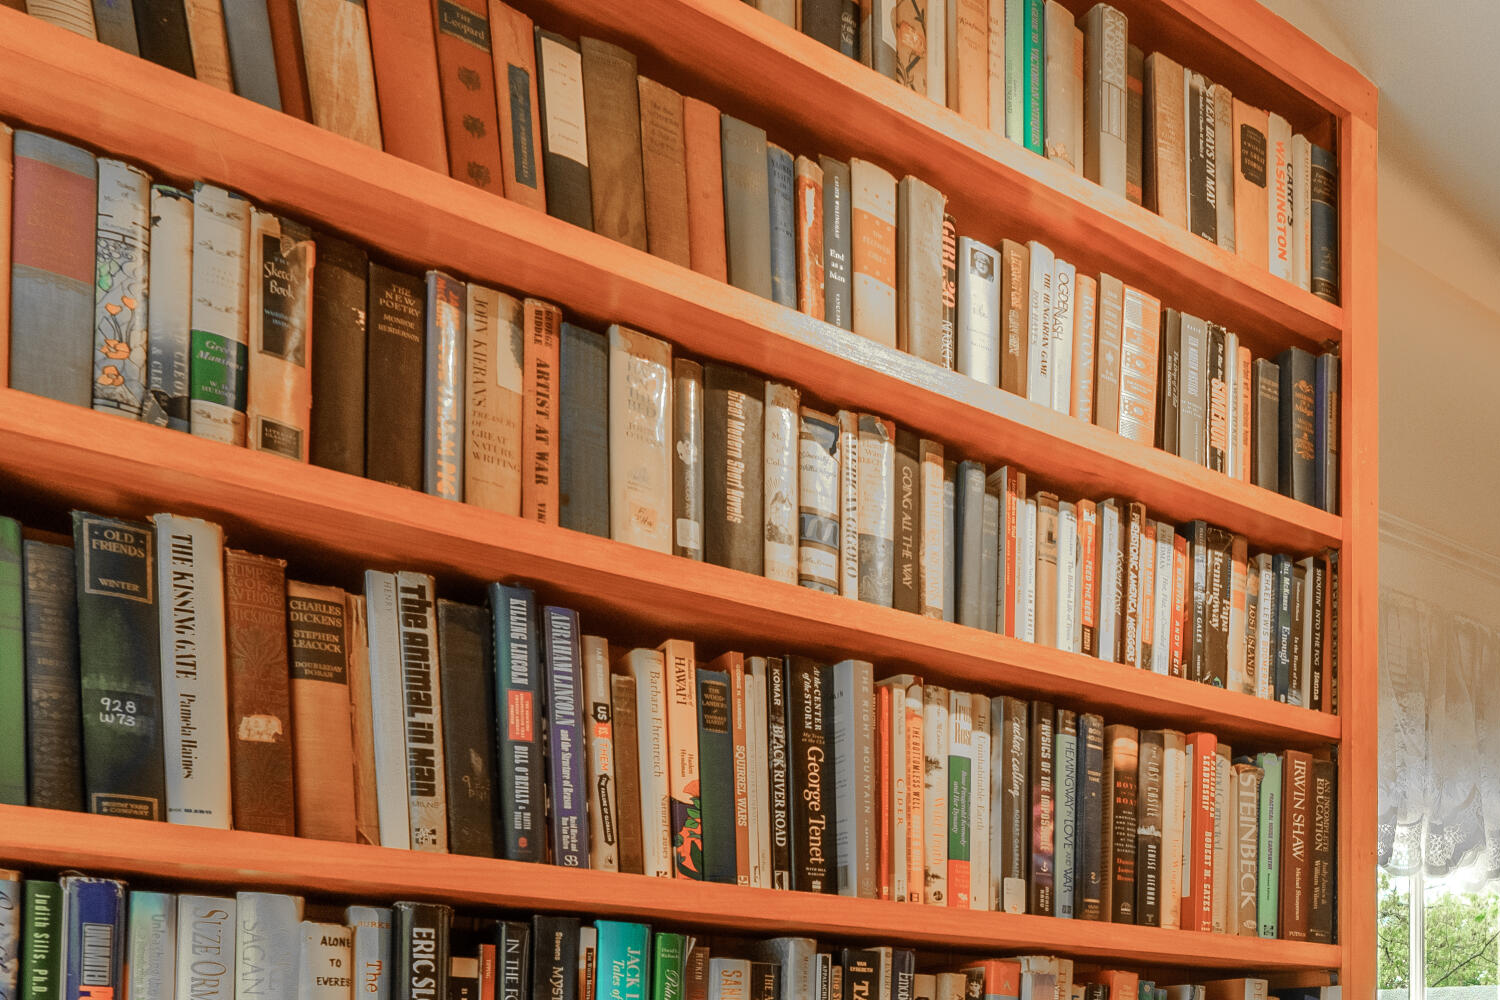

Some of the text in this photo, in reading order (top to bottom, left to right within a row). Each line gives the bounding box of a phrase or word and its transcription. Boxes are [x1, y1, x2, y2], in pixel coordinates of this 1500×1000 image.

[1206, 125, 1216, 209] DAYS IN MAY
[1275, 140, 1288, 262] WASHINGTON
[535, 358, 551, 486] ARTIST AT WAR
[725, 390, 746, 523] Great Modern Short Novels
[92, 538, 145, 558] FRIENDS
[103, 528, 135, 544] OLD
[902, 465, 914, 590] GOING ALL THE WAY
[98, 577, 141, 593] WINTER
[1127, 570, 1138, 614] AMERICA
[1209, 551, 1224, 632] Hemingway
[289, 600, 342, 617] CHARLES
[290, 611, 342, 628] DICKENS
[509, 597, 528, 640] KILLING
[1262, 606, 1271, 637] LEWIS
[171, 533, 199, 780] THE KISSING GATE Pamela Haines
[292, 639, 342, 654] LEACOCK
[293, 629, 340, 643] STEPHEN
[1277, 625, 1291, 665] Enough
[1312, 609, 1322, 701] INTO THE FOG Hanna
[509, 642, 529, 685] LINCOLN
[550, 611, 576, 727] ABRAHAM LINCOLN
[100, 696, 137, 715] 928
[597, 705, 608, 721] US
[803, 691, 812, 730] STORM
[813, 688, 823, 731] CENTER
[513, 744, 529, 764] BILL
[599, 742, 609, 772] THEM
[771, 667, 786, 847] KOMAR BLACK RIVER ROAD
[1040, 718, 1051, 793] PHYSICS OF THE
[514, 766, 530, 805] O'REILLY
[735, 744, 747, 827] SQUIRREL WARS
[802, 745, 826, 865] George Tenet
[1062, 741, 1075, 893] HEMINGWAY LOVE WAR
[1291, 759, 1307, 863] IRWIN SHAW
[1314, 777, 1324, 852] EDUCATION
[1239, 772, 1257, 909] STEINBECK
[33, 892, 52, 929] Judith
[319, 935, 352, 949] ALONE
[412, 927, 436, 974] ERIC
[506, 938, 520, 954] IN
[328, 957, 343, 969] TO
[365, 959, 383, 993] The
[504, 957, 520, 984] THE
[611, 959, 626, 987] Tales
[625, 946, 641, 989] JACK
[610, 988, 624, 1000] of
